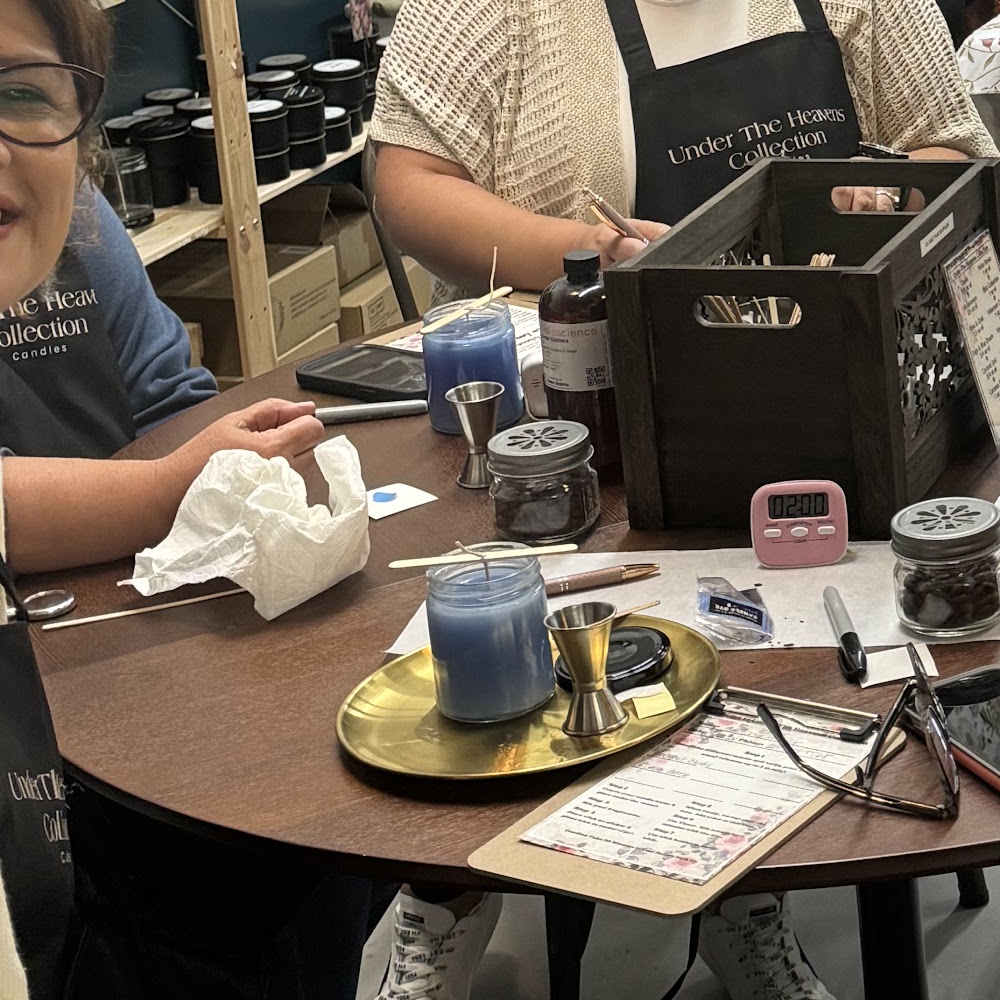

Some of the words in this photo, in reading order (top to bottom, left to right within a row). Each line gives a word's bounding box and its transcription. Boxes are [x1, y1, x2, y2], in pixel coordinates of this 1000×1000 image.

[667, 133, 734, 166] Under
[737, 118, 784, 143] The
[786, 107, 847, 129] Heavens
[727, 129, 828, 171] Collection
[773, 493, 825, 518] 02:00
